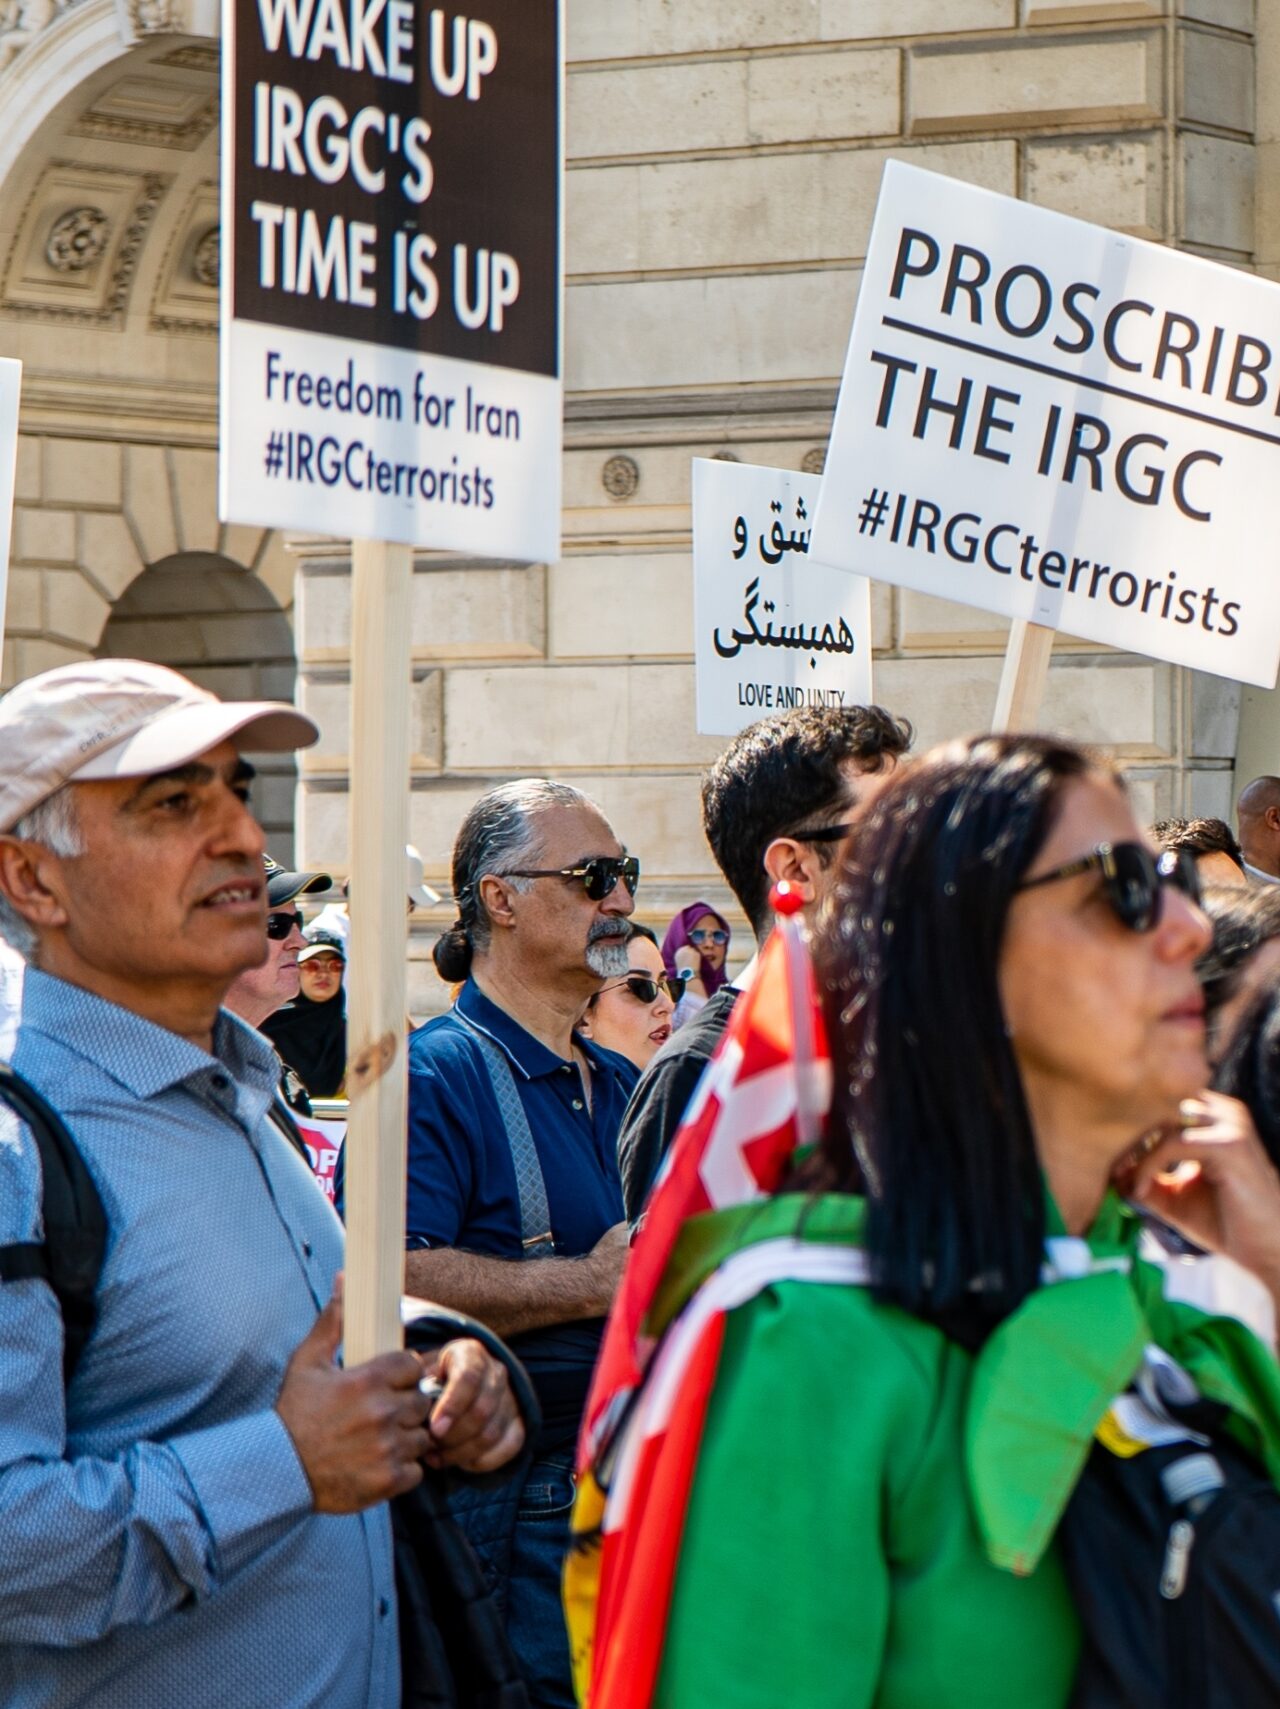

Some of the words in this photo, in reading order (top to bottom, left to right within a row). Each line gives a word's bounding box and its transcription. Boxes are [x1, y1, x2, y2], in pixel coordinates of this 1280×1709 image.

[256, 0, 414, 84] WAKE
[429, 9, 498, 101] UP
[253, 81, 434, 204] IRGC'S
[251, 200, 377, 308] TIME
[393, 229, 439, 321] IS
[453, 243, 521, 333] UP
[264, 350, 402, 422] Freedom
[413, 372, 456, 431] for
[466, 386, 521, 442] Iran
[869, 350, 1022, 466] THE
[1036, 403, 1224, 523] IRGC
[263, 428, 495, 510] #IRGCterrorists
[731, 515, 749, 560] و
[759, 496, 812, 565] شق
[857, 486, 1241, 638] #IRGCterrorists
[713, 576, 855, 670] همبستگی
[738, 682, 773, 708] LOVE
[776, 686, 805, 709] AND
[807, 688, 846, 709] UNITY
